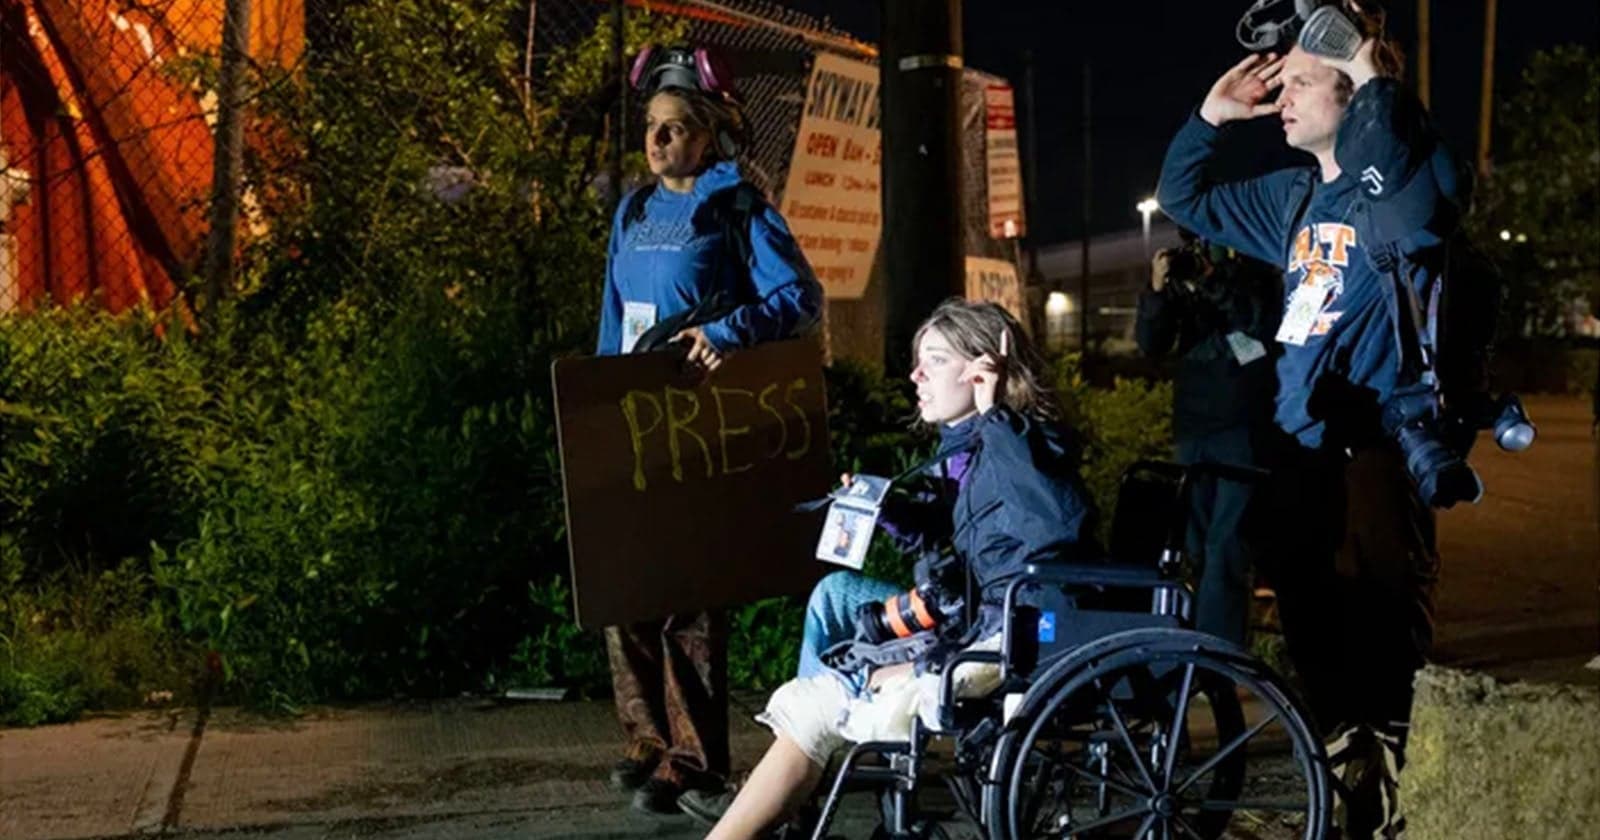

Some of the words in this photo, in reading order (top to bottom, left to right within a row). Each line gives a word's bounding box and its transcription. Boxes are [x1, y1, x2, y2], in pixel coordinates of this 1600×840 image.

[806, 69, 874, 126] SKYWAY
[807, 132, 838, 158] OPEN
[619, 377, 812, 491] PRESS
